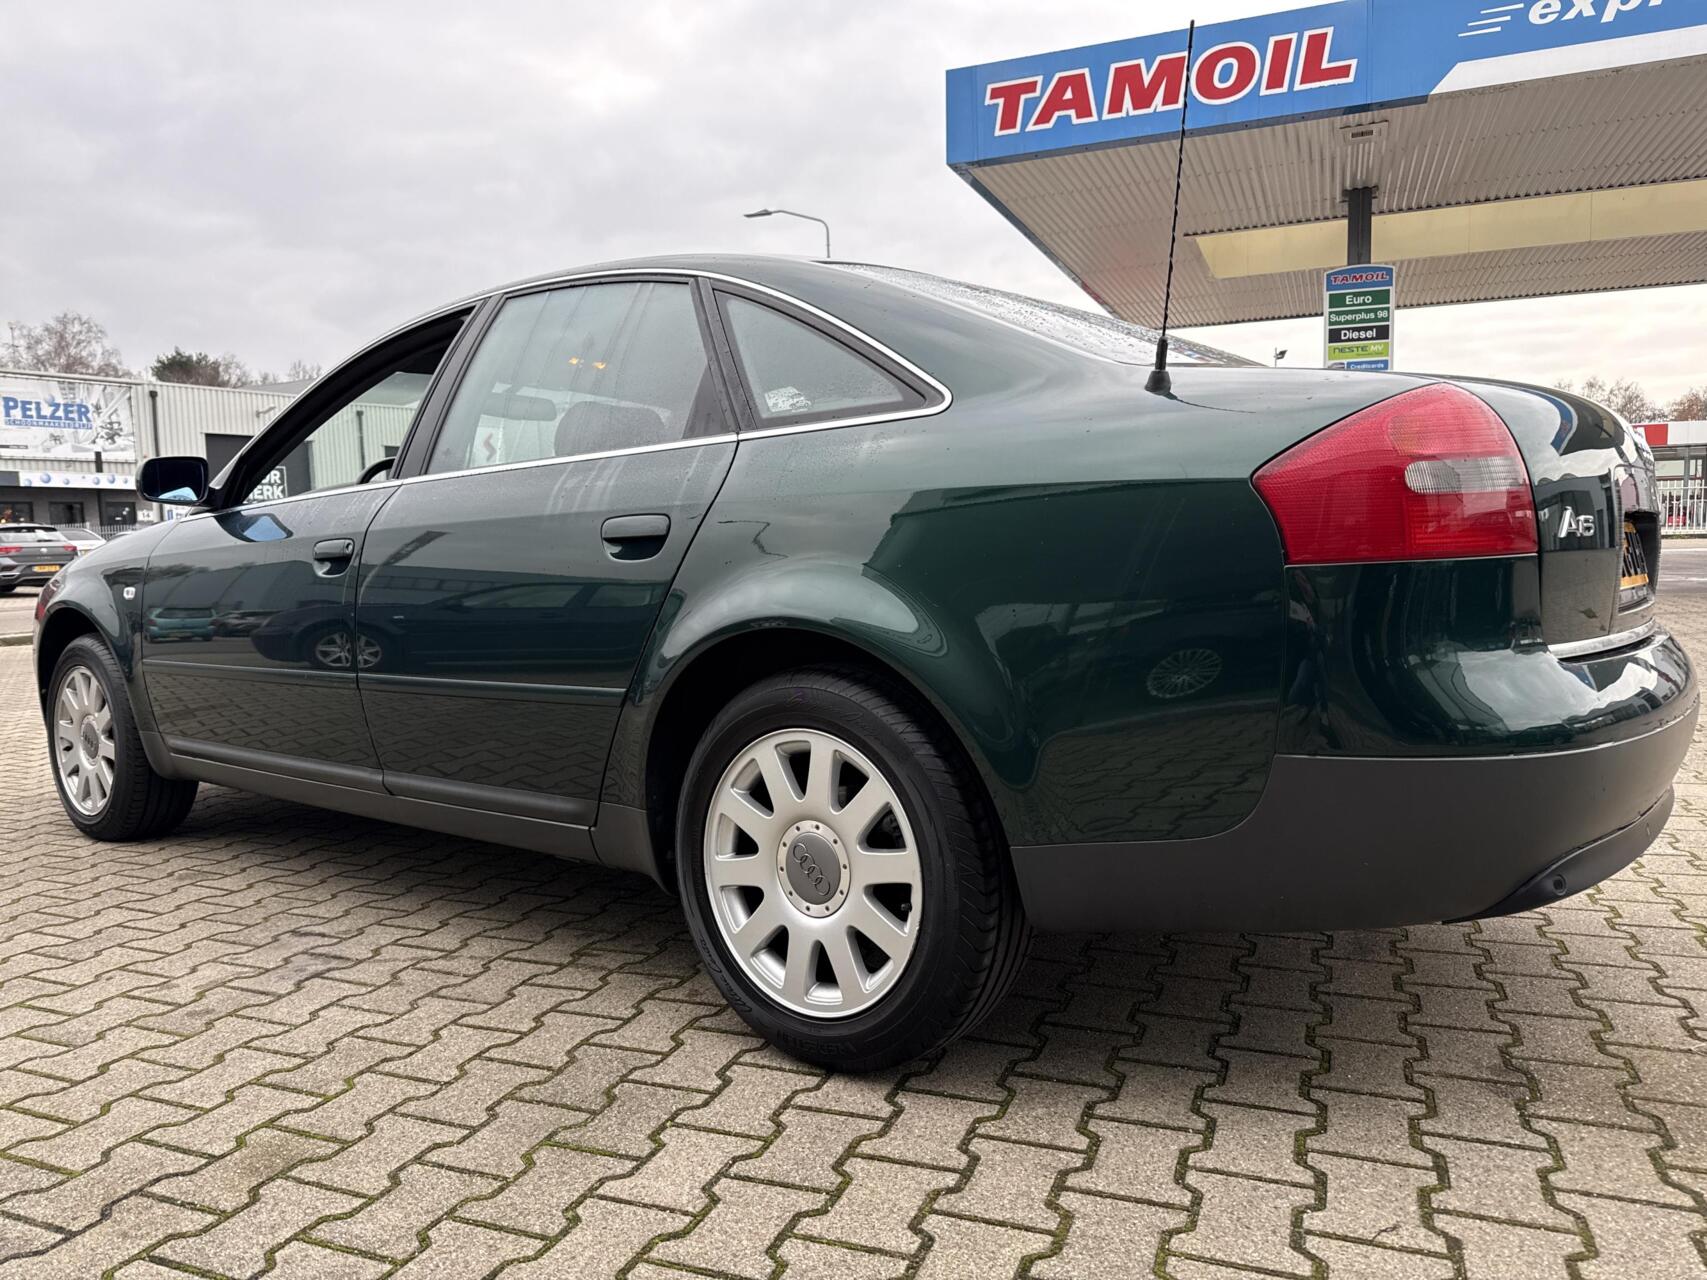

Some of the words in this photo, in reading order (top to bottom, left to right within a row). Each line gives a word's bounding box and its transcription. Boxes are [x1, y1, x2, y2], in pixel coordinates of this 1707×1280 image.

[1528, 0, 1664, 25] exp
[985, 26, 1358, 137] TAMOIL
[1331, 272, 1389, 285] TAMOIL
[1345, 295, 1373, 305] Euro
[1330, 311, 1375, 323] Superplus
[1377, 310, 1388, 319] 98
[1341, 328, 1376, 340] Diesel
[2, 396, 92, 422] PELZER
[1557, 505, 1595, 538] A6
